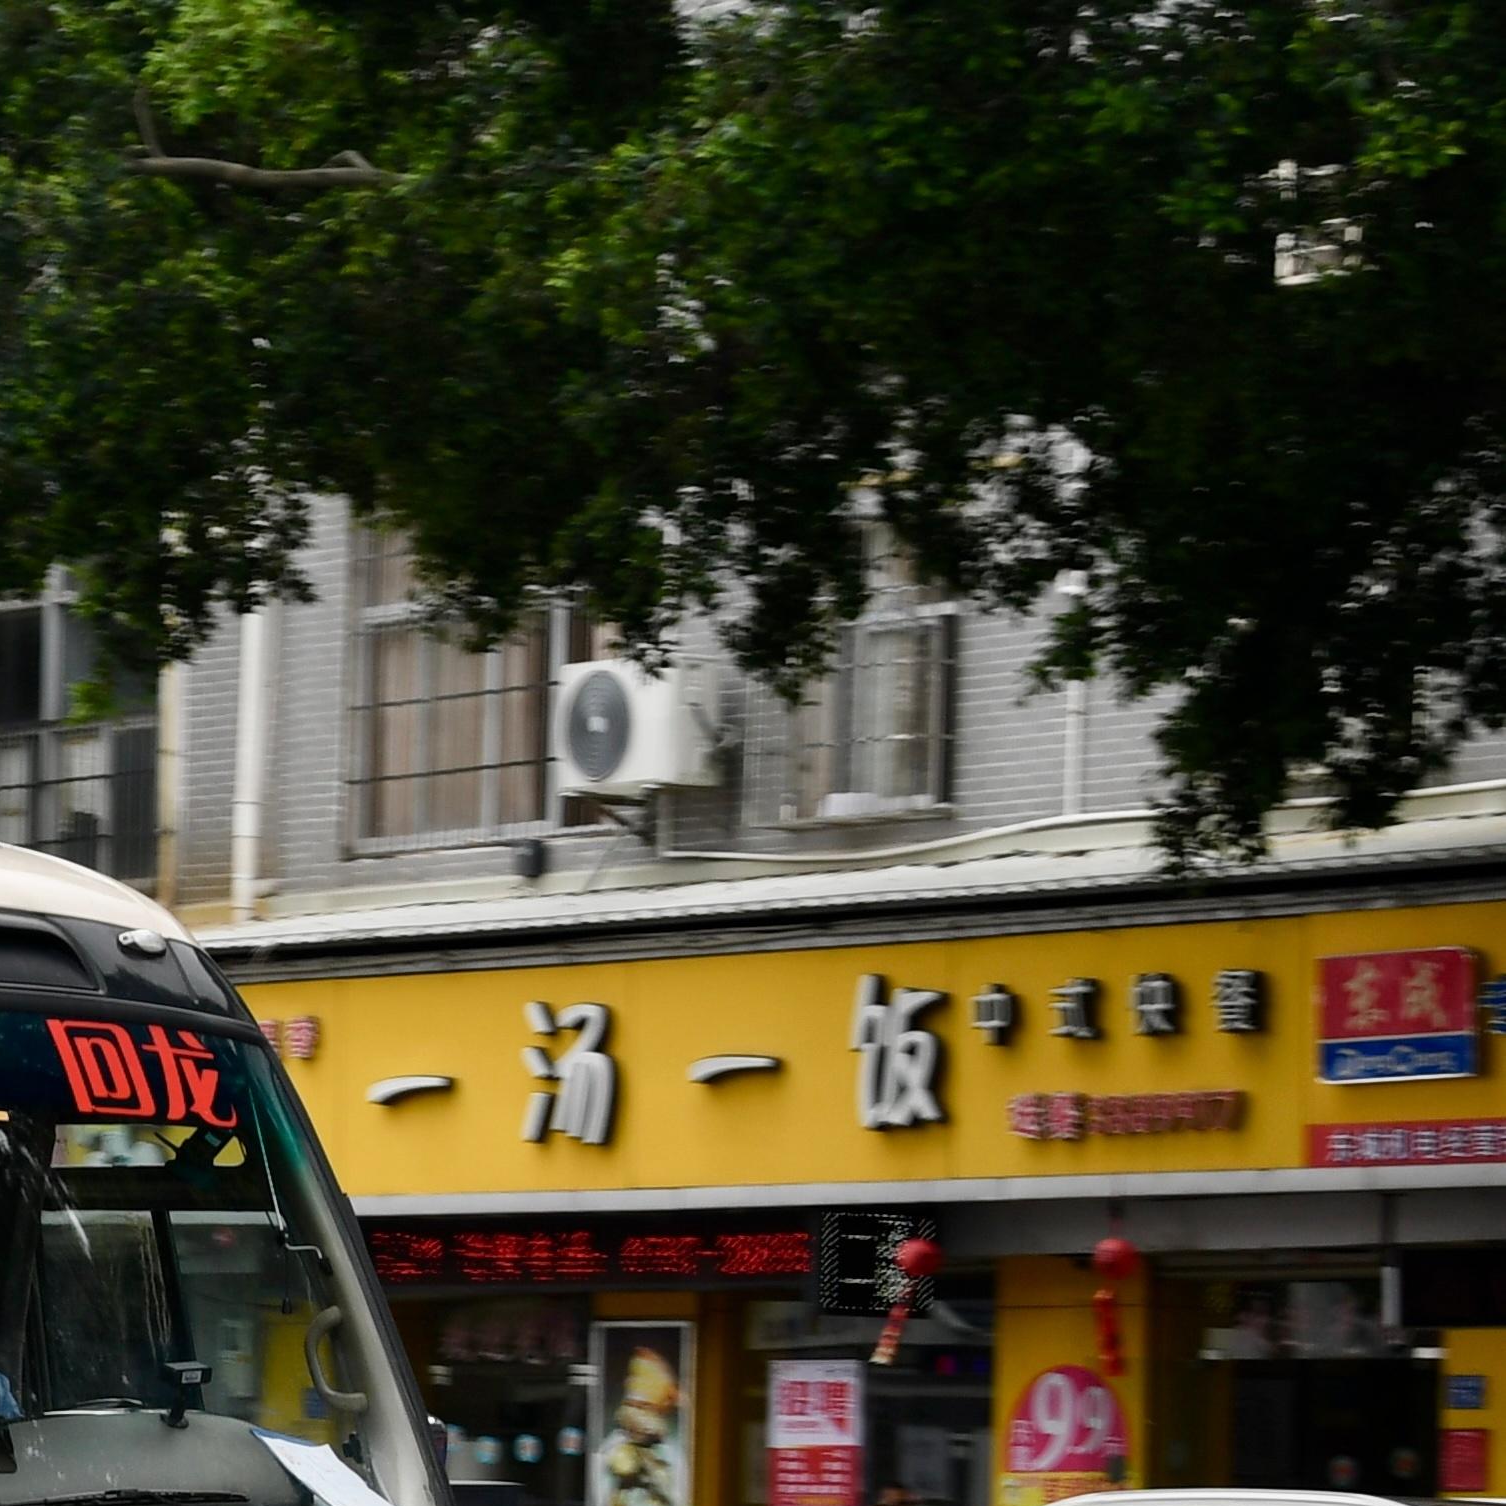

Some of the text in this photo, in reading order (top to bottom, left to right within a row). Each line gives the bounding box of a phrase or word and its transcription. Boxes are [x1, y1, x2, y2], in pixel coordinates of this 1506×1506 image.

[365, 972, 950, 1147] 一汤一饭
[970, 967, 1266, 1047] 中式快餐
[44, 1016, 238, 1129] 回龙
